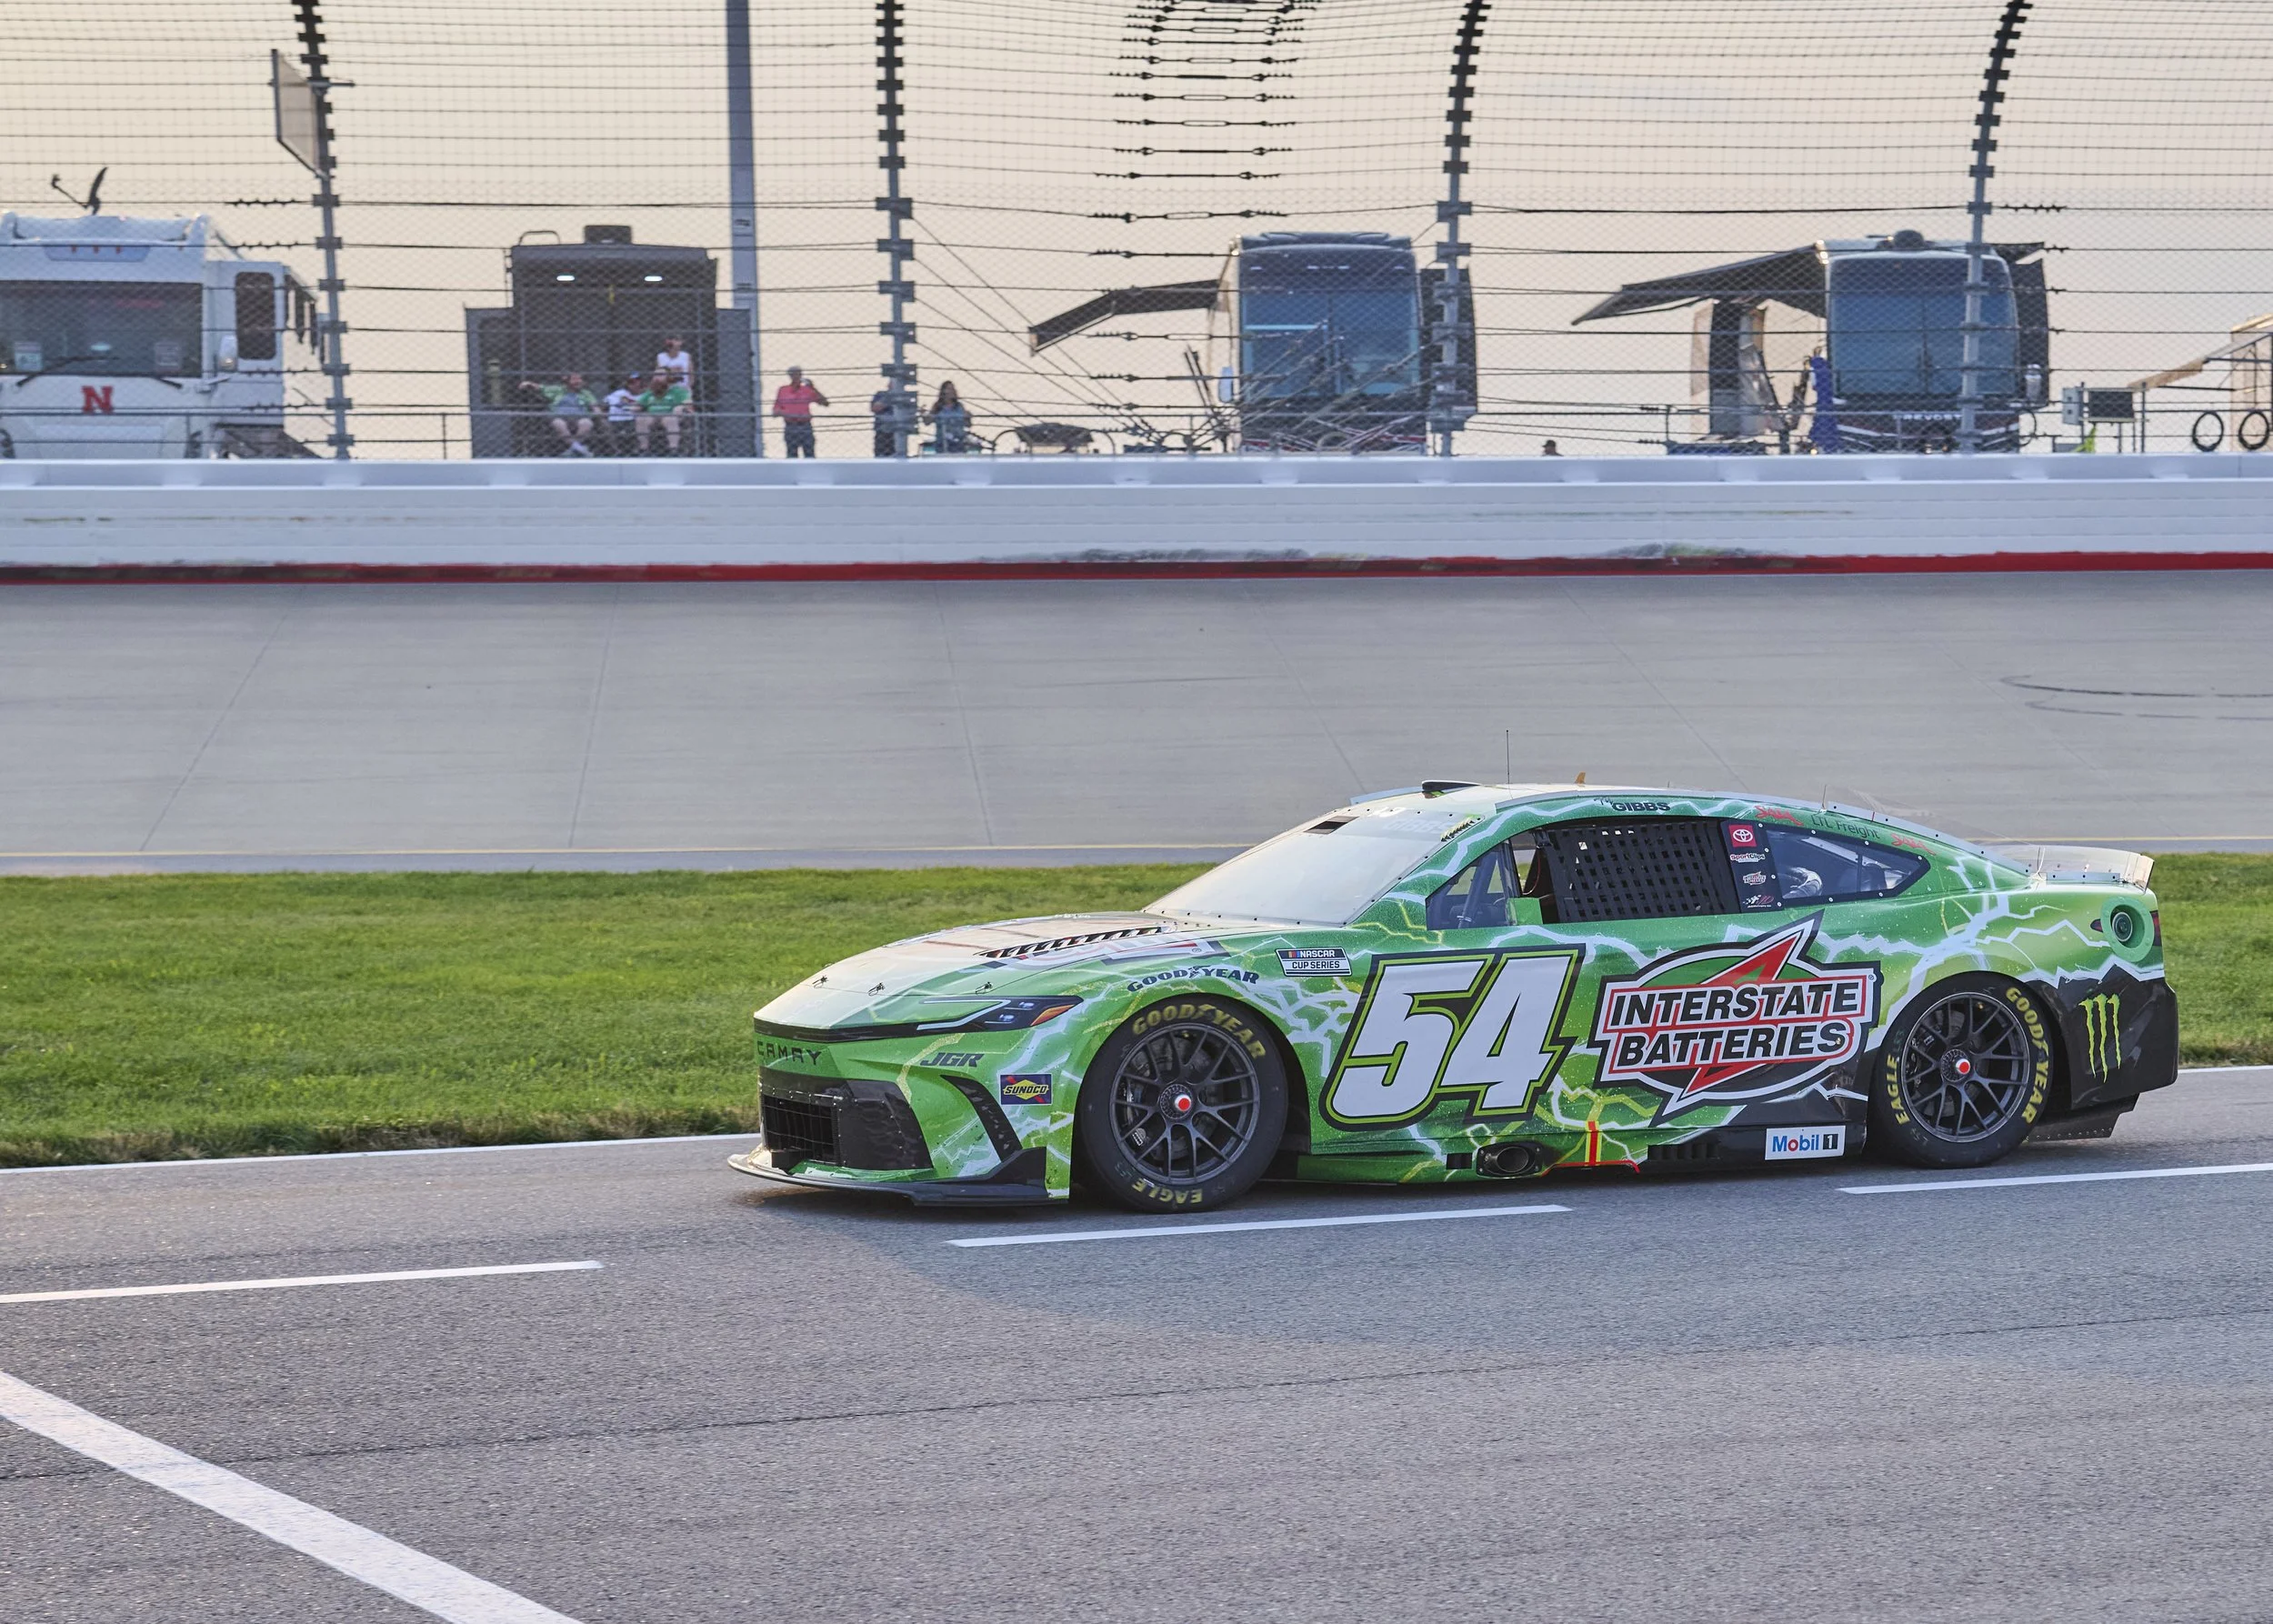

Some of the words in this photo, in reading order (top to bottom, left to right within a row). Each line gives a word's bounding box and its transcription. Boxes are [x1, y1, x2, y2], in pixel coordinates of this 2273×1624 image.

[82, 386, 114, 414] N
[1612, 802, 1671, 811] GIBBS
[1811, 815, 1833, 829] LTL
[1836, 821, 1880, 839] Freight
[1300, 950, 1335, 958] NASCAR
[1310, 960, 1340, 968] SERIES
[1126, 966, 1259, 992] GOODYEAR
[1610, 982, 1859, 1027] INTERSTATE
[1132, 1004, 1267, 1059] GOODYEAR
[1330, 955, 1573, 1118] 54
[756, 1040, 822, 1066] CAMRY
[1617, 1022, 1847, 1068] BATTERIES
[2005, 987, 2049, 1124] GOODYEAR
[920, 1052, 985, 1068] JGR
[1005, 1086, 1047, 1095] SUNOCO
[1886, 1054, 1910, 1126] EAGLE
[1772, 1135, 1819, 1152] Mobil
[1132, 1178, 1203, 1204] EAGLE
